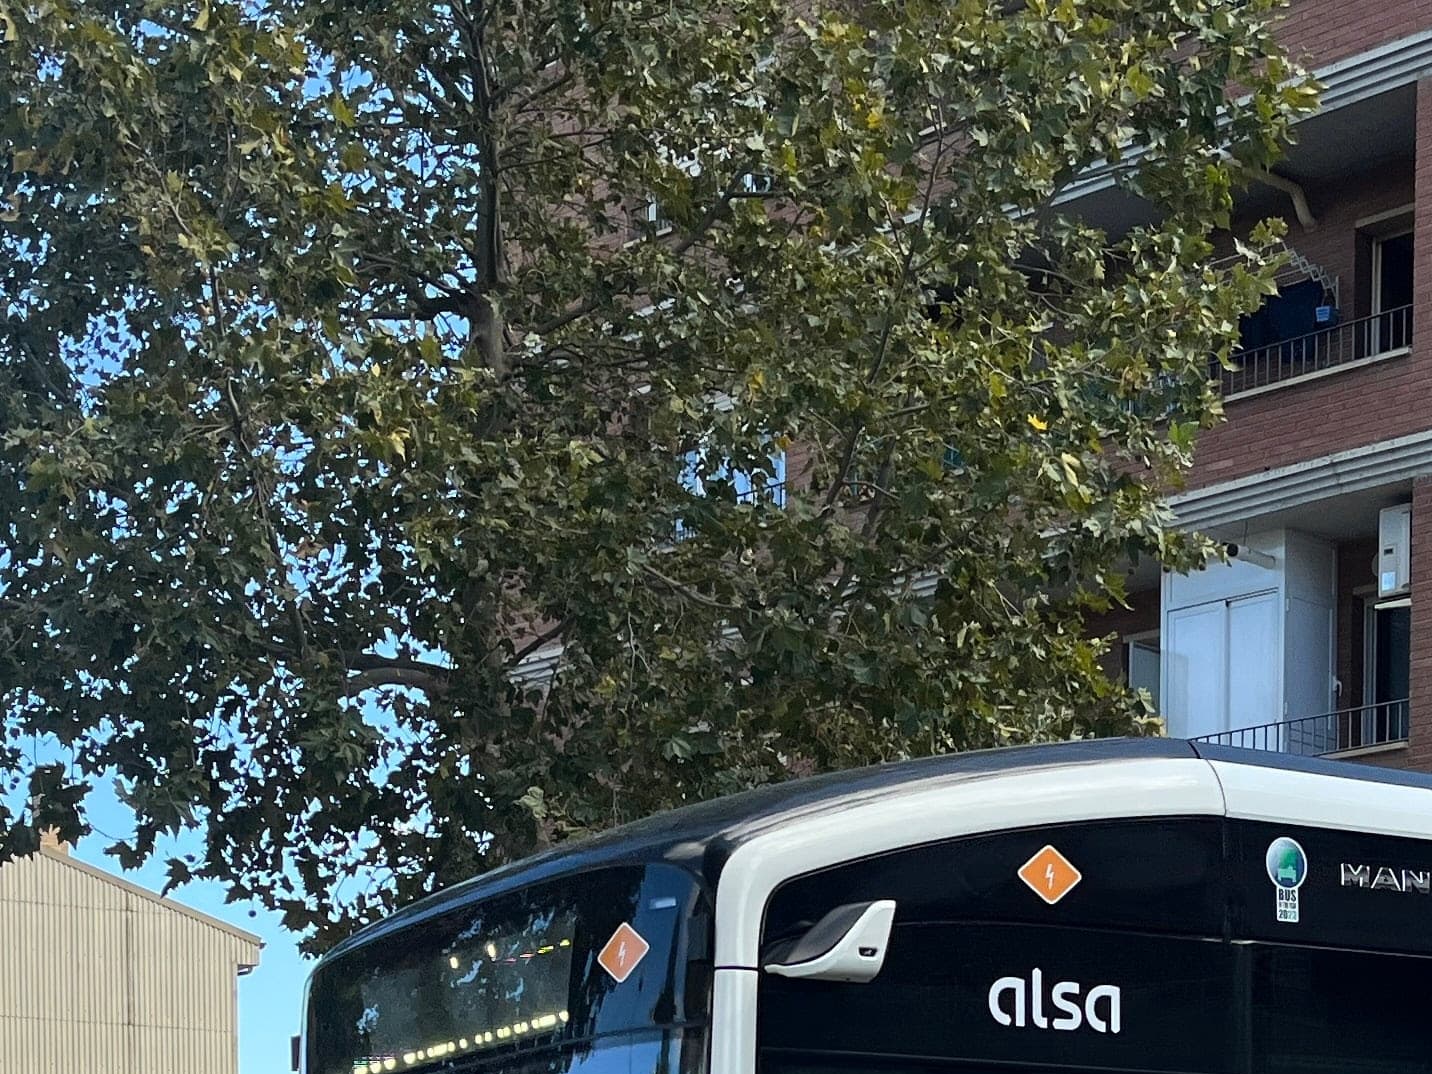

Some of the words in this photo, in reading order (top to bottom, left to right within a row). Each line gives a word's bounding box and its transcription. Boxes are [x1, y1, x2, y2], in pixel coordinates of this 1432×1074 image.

[1340, 862, 1430, 894] MAN
[1278, 889, 1297, 902] BUS
[988, 967, 1121, 1034] alsa
